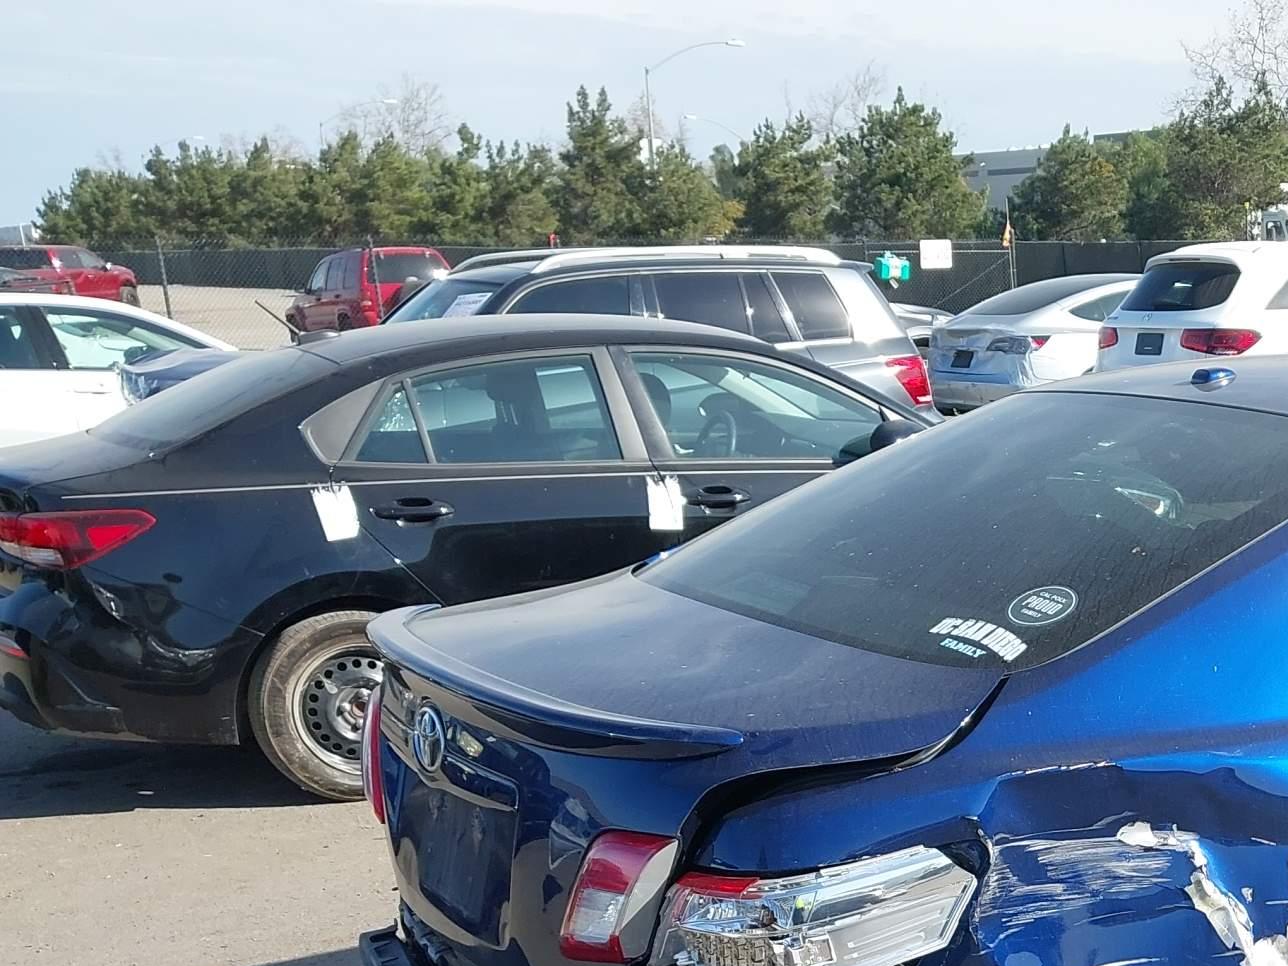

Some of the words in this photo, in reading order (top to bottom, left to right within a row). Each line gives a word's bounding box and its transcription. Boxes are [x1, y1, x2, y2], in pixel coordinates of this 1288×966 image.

[1022, 595, 1063, 615] PROUD
[1051, 595, 1067, 604] POLY
[1020, 608, 1042, 618] FAMILY
[940, 638, 987, 658] FAMILY
[950, 618, 998, 641] SAN
[980, 626, 1028, 661] DIEGO
